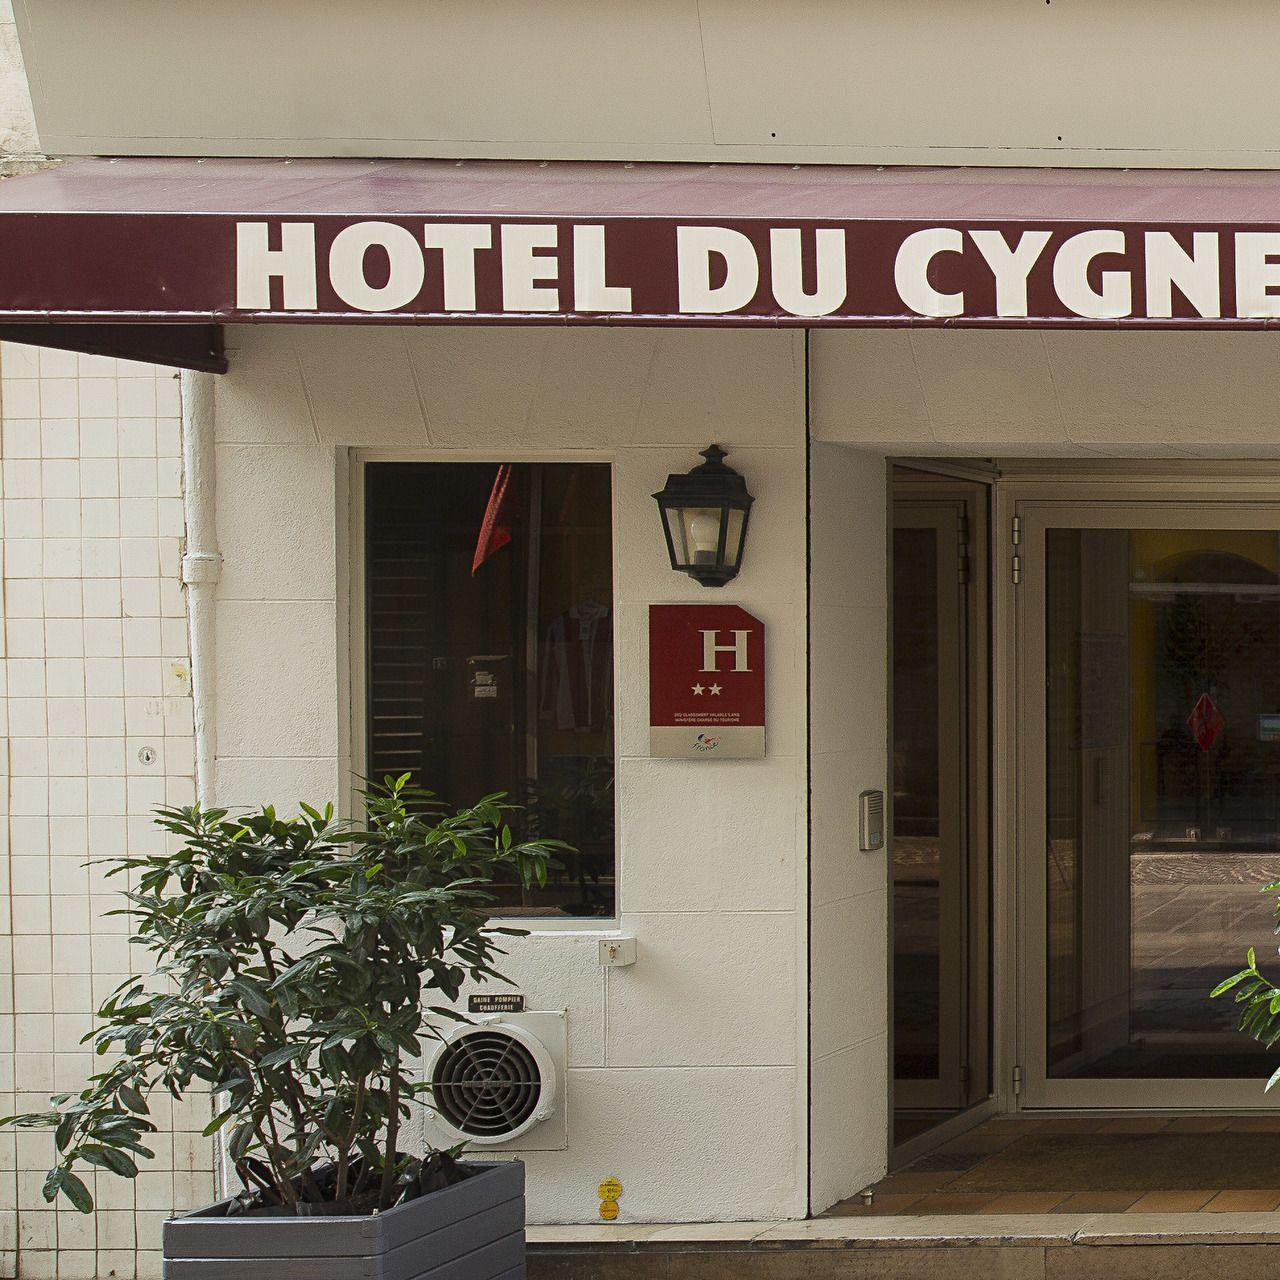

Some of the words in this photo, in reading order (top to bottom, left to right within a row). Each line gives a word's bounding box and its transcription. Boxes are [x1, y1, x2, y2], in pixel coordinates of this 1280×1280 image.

[236, 221, 633, 313] HOTEL
[676, 225, 848, 318] DU
[698, 629, 753, 672] H
